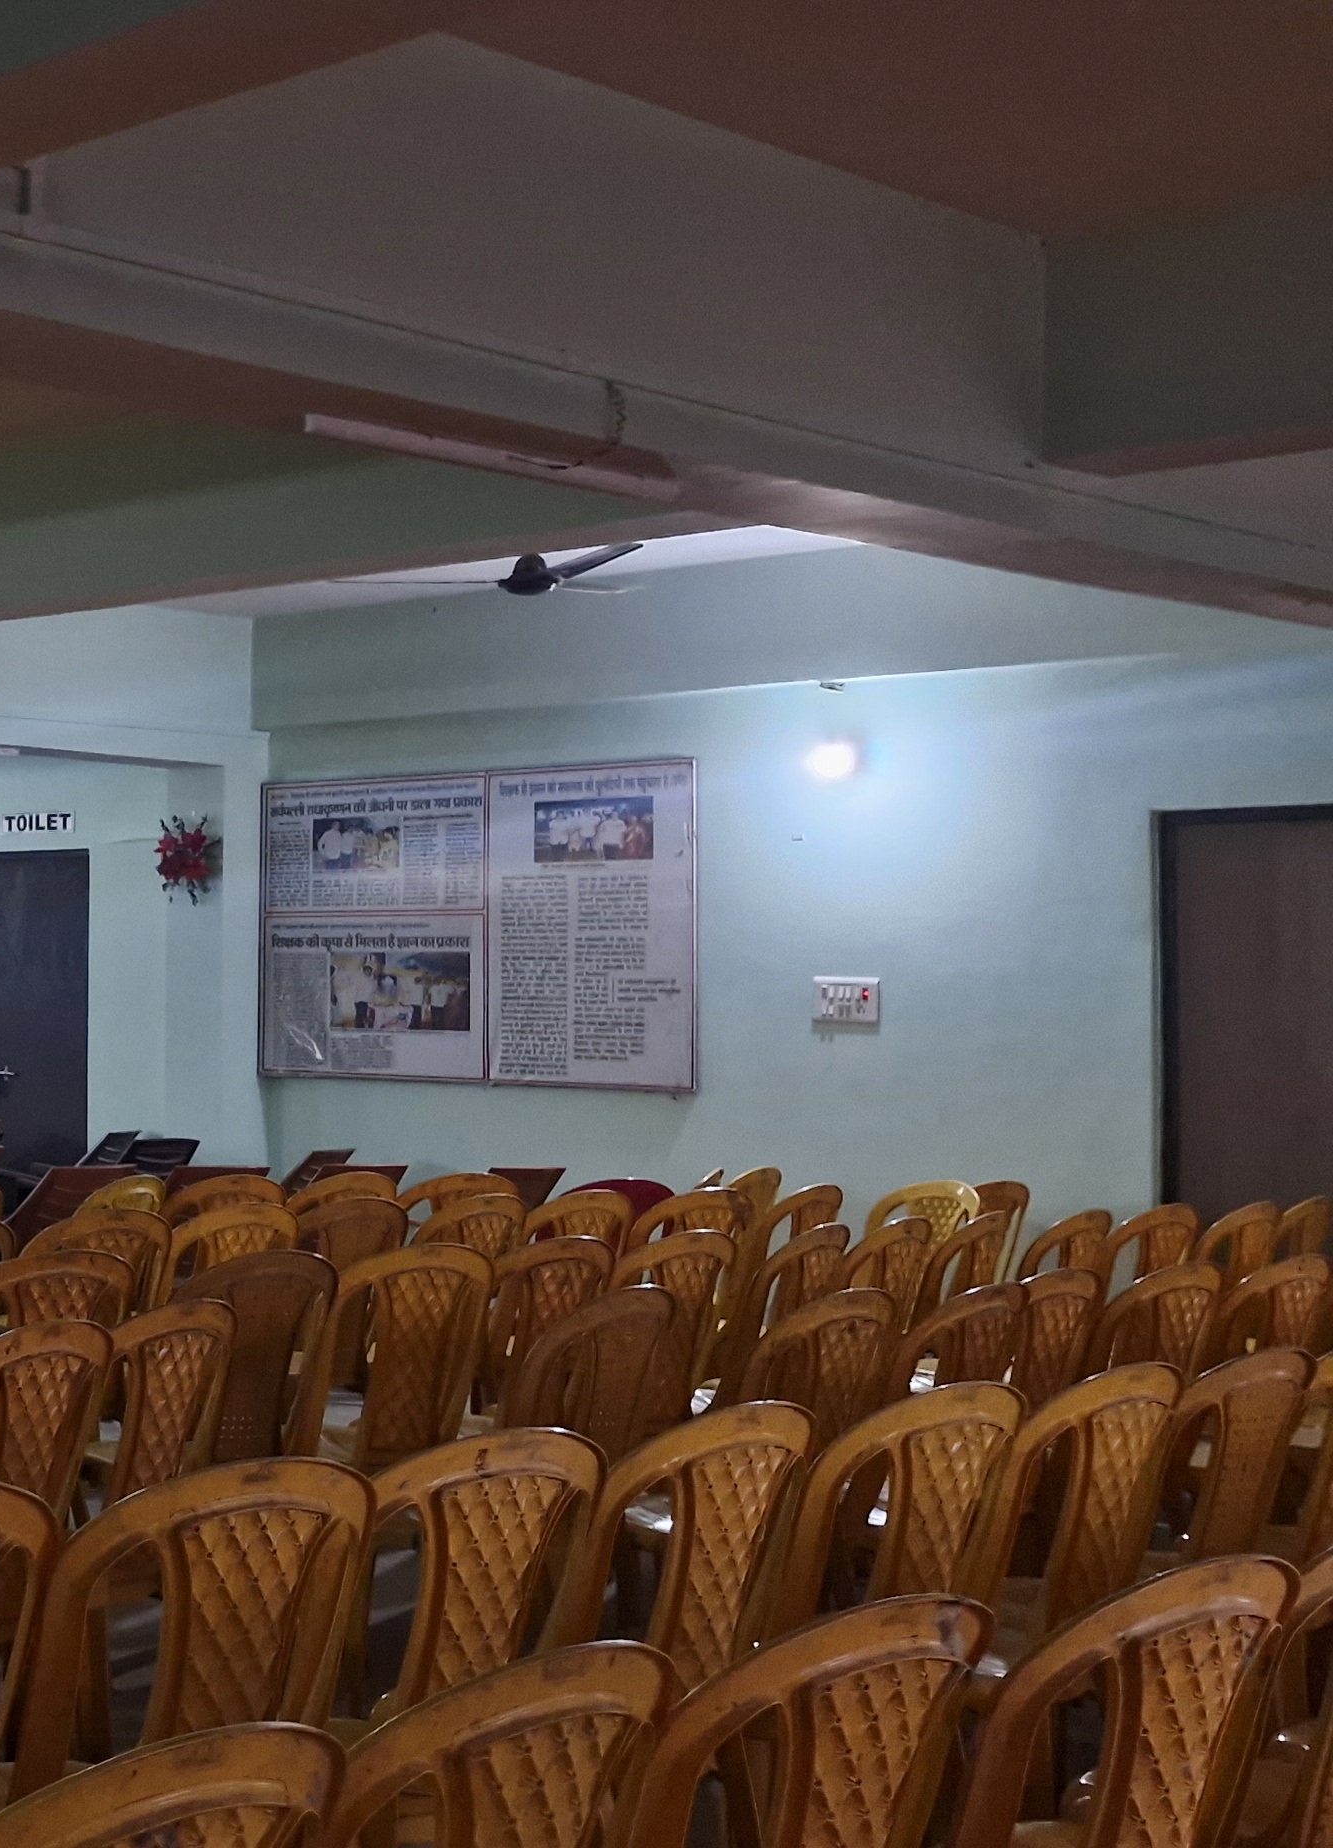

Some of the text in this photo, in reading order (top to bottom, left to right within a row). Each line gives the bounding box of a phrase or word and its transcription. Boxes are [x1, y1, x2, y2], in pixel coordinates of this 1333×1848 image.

[396, 800, 408, 811] पर
[4, 813, 71, 832] TOILET
[306, 934, 320, 948] की
[344, 933, 353, 948] से
[420, 936, 435, 948] का
